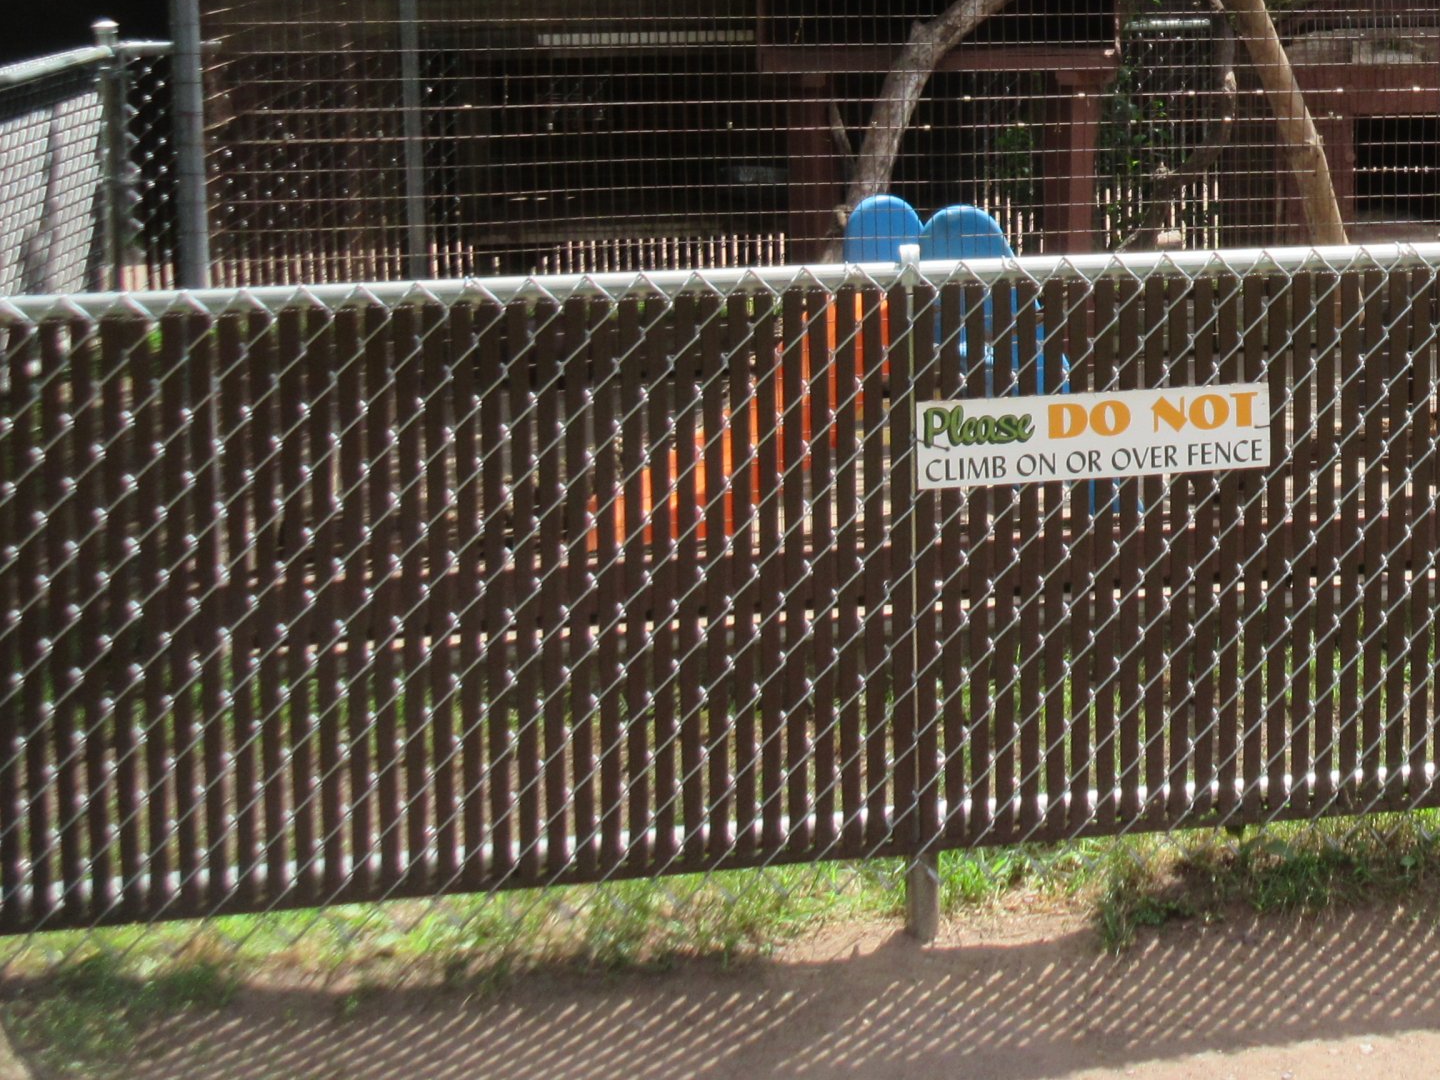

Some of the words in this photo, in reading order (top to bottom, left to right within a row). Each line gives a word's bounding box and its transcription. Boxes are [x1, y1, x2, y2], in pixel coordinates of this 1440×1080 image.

[923, 404, 1036, 449] Please
[1047, 400, 1132, 440] DO
[1151, 391, 1258, 433] NOT
[925, 455, 1008, 483] CLIMB
[1016, 452, 1056, 477] ON
[1066, 450, 1103, 474] OR
[1111, 444, 1178, 471] OVER
[1187, 438, 1263, 466] FENCE
